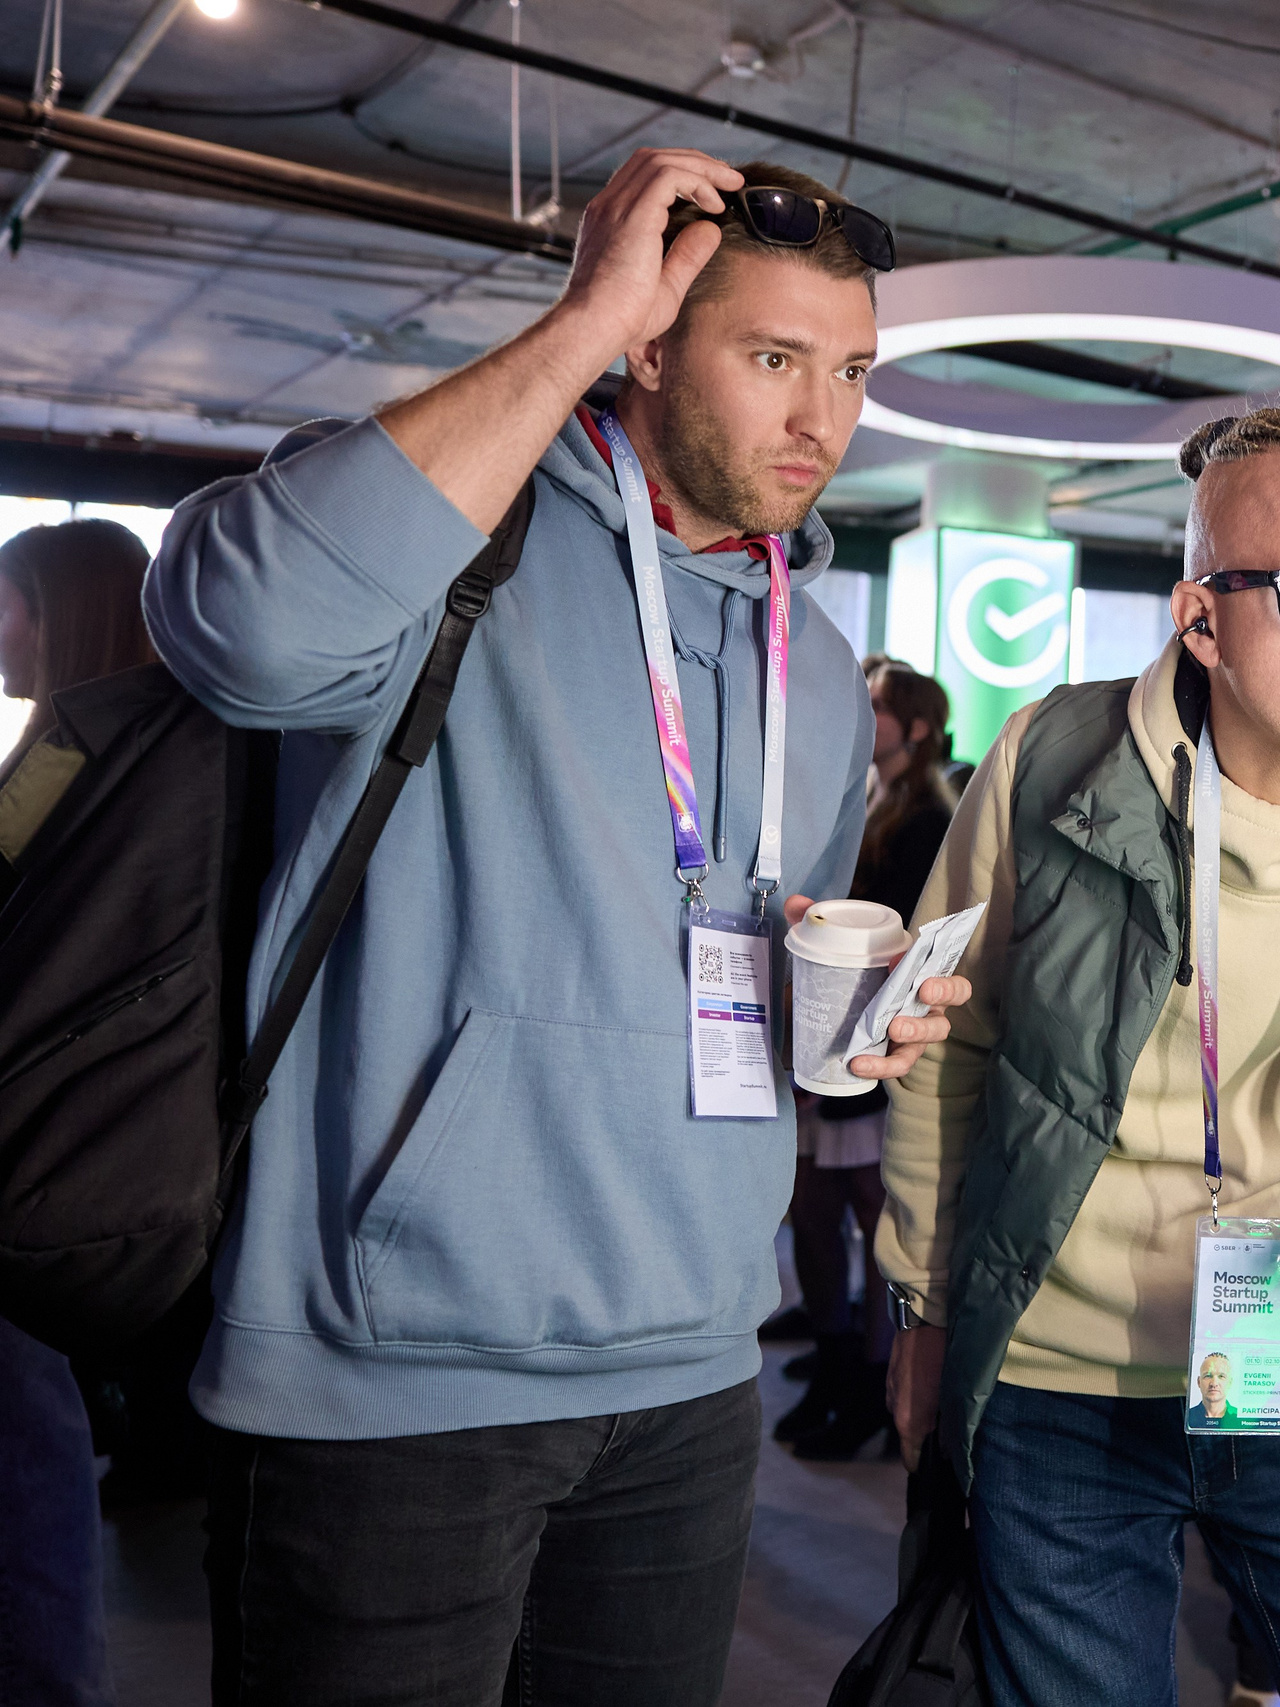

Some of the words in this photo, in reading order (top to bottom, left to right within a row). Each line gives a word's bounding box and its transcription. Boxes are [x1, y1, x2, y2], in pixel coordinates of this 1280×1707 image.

[622, 457, 643, 503] Summit
[773, 595, 785, 648] Summit
[642, 566, 660, 625] Moscow
[652, 628, 670, 685] Startup
[661, 688, 682, 747] Summit
[770, 651, 783, 704] Startup
[769, 708, 780, 763] Moscow
[1202, 864, 1213, 923] Moscow
[1202, 928, 1213, 986] Startup
[1203, 990, 1214, 1049] Summit
[1212, 1285, 1269, 1302] Startup
[1213, 1271, 1272, 1285] Moscow
[1212, 1299, 1274, 1314] Summit
